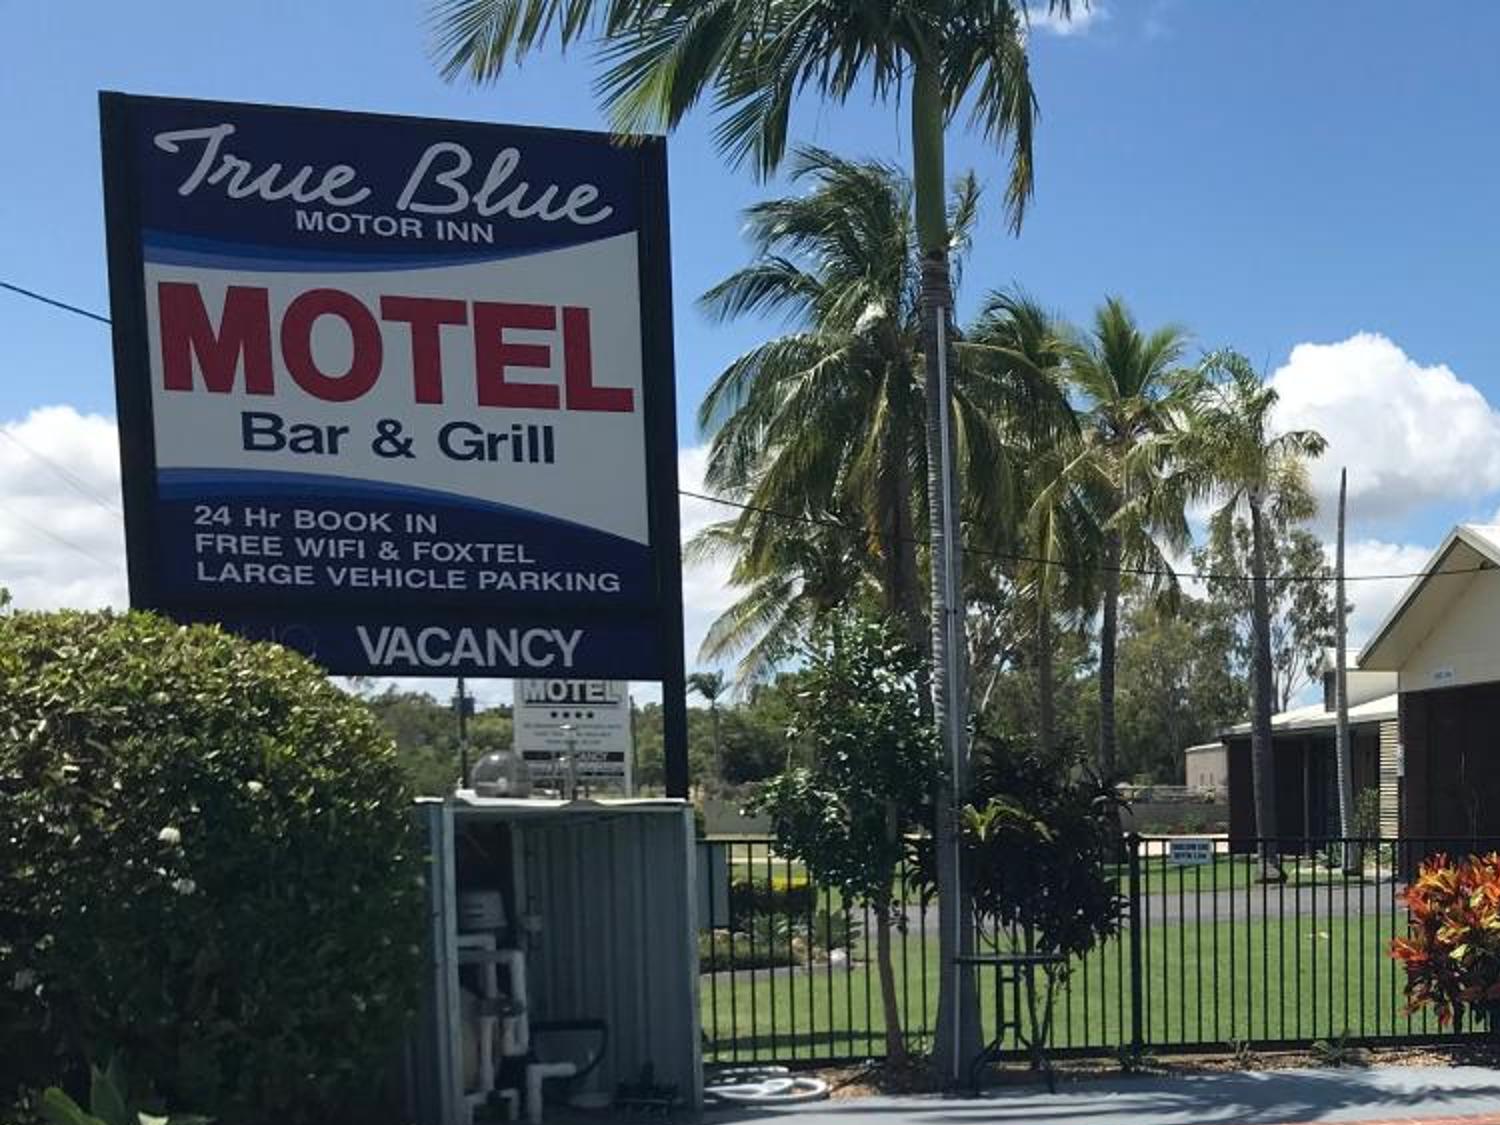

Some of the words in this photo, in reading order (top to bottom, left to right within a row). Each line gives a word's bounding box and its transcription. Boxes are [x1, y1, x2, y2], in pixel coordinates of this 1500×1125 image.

[154, 124, 371, 207] True
[397, 142, 613, 225] Blue
[296, 209, 423, 240] MOTOR
[436, 218, 495, 244] INN
[157, 281, 635, 413] MOTEL
[241, 411, 349, 456] Bar
[371, 418, 416, 459] &
[438, 420, 556, 464] Grill
[194, 505, 232, 526] 24
[244, 507, 282, 529] Hr
[294, 509, 393, 534] BOOK
[405, 512, 438, 535] IN
[195, 533, 283, 557] FREE
[295, 537, 366, 560] WIFI
[378, 541, 400, 561] &
[413, 541, 536, 564] FOXTEL
[197, 561, 316, 586] LARGE
[327, 566, 468, 590] VEHICLE
[479, 571, 622, 593] PARKING
[357, 625, 584, 668] VACANCY
[522, 680, 620, 702] MOTEL
